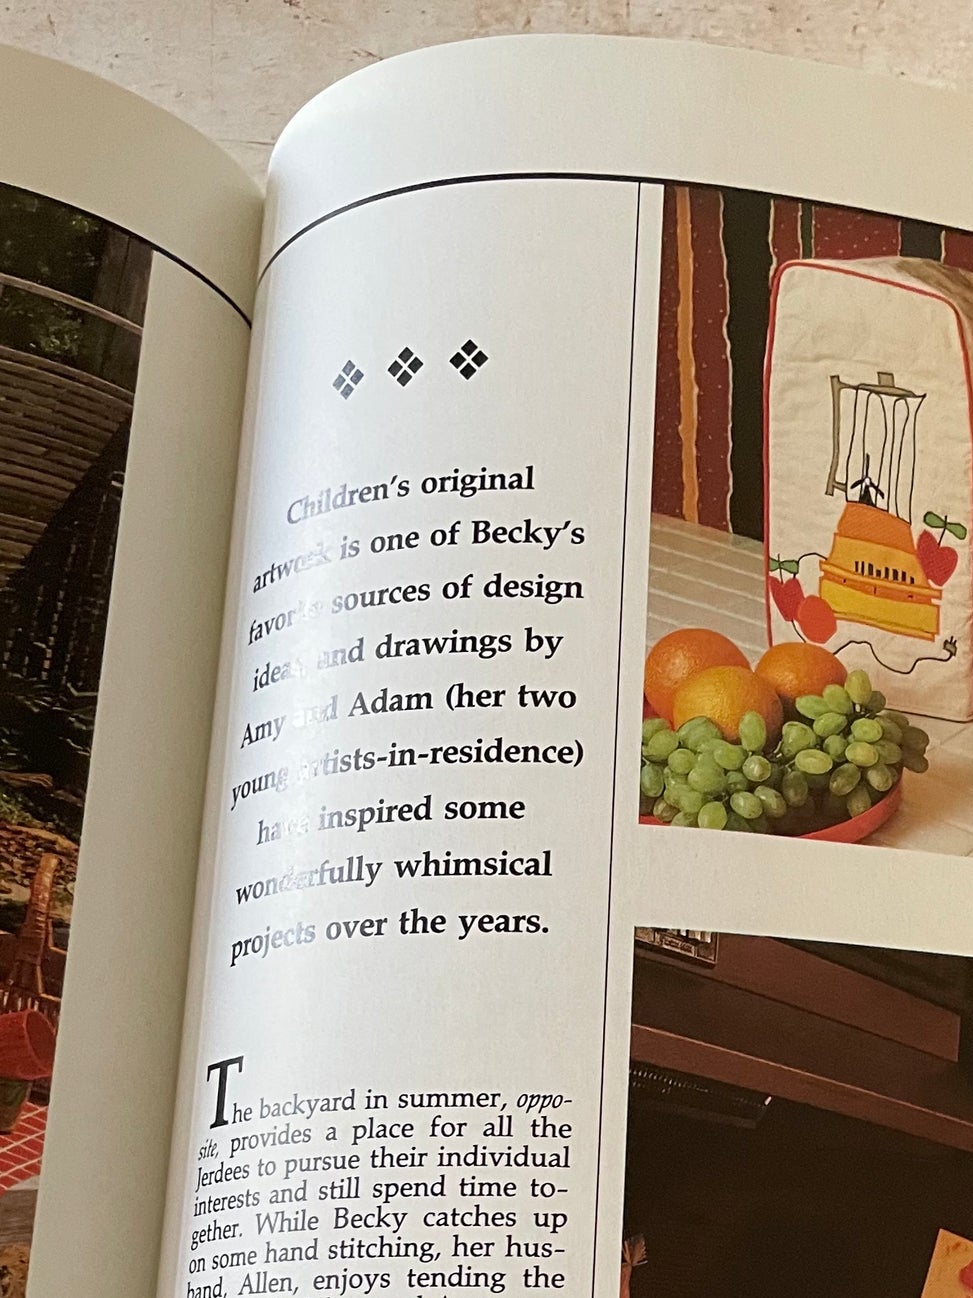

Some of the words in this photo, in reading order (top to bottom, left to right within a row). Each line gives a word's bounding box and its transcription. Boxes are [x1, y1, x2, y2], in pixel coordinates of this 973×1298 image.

[287, 475, 410, 524] Children's
[421, 465, 535, 498] original
[340, 536, 360, 560] is
[370, 530, 419, 554] one
[430, 520, 462, 546] of
[471, 519, 585, 550] Becky's
[332, 584, 430, 613] sources
[442, 574, 474, 599] of
[483, 573, 584, 604] design
[317, 637, 365, 670] and
[375, 629, 512, 659] drawings
[524, 627, 564, 659] by
[240, 717, 284, 749] Amy
[348, 688, 434, 717] Adam
[446, 683, 506, 711] (her
[518, 685, 576, 708] two
[231, 767, 288, 811] young
[318, 794, 432, 832] inspired
[444, 801, 525, 820] some
[394, 850, 552, 878] whimsical
[230, 925, 315, 967] projects
[326, 918, 388, 940] over
[399, 908, 446, 935] the
[458, 914, 548, 940] years.
[260, 1088, 356, 1120] backyard
[364, 1089, 388, 1109] in
[398, 1093, 507, 1111] summer,
[516, 1094, 572, 1114] oppo-
[195, 1161, 250, 1193] Jerdees
[257, 1159, 276, 1177] to
[283, 1155, 360, 1180] pursue
[370, 1146, 428, 1168] their
[437, 1144, 570, 1168] individual
[191, 1219, 242, 1251] gether.
[256, 1209, 319, 1235] While
[333, 1205, 408, 1234] Becky
[423, 1204, 516, 1227] catches
[533, 1213, 568, 1234] up
[189, 1258, 206, 1274] on
[212, 1251, 257, 1270] some
[264, 1238, 318, 1263] hand
[328, 1235, 441, 1263] stitching,
[451, 1234, 495, 1257] her
[504, 1234, 565, 1258] hus-
